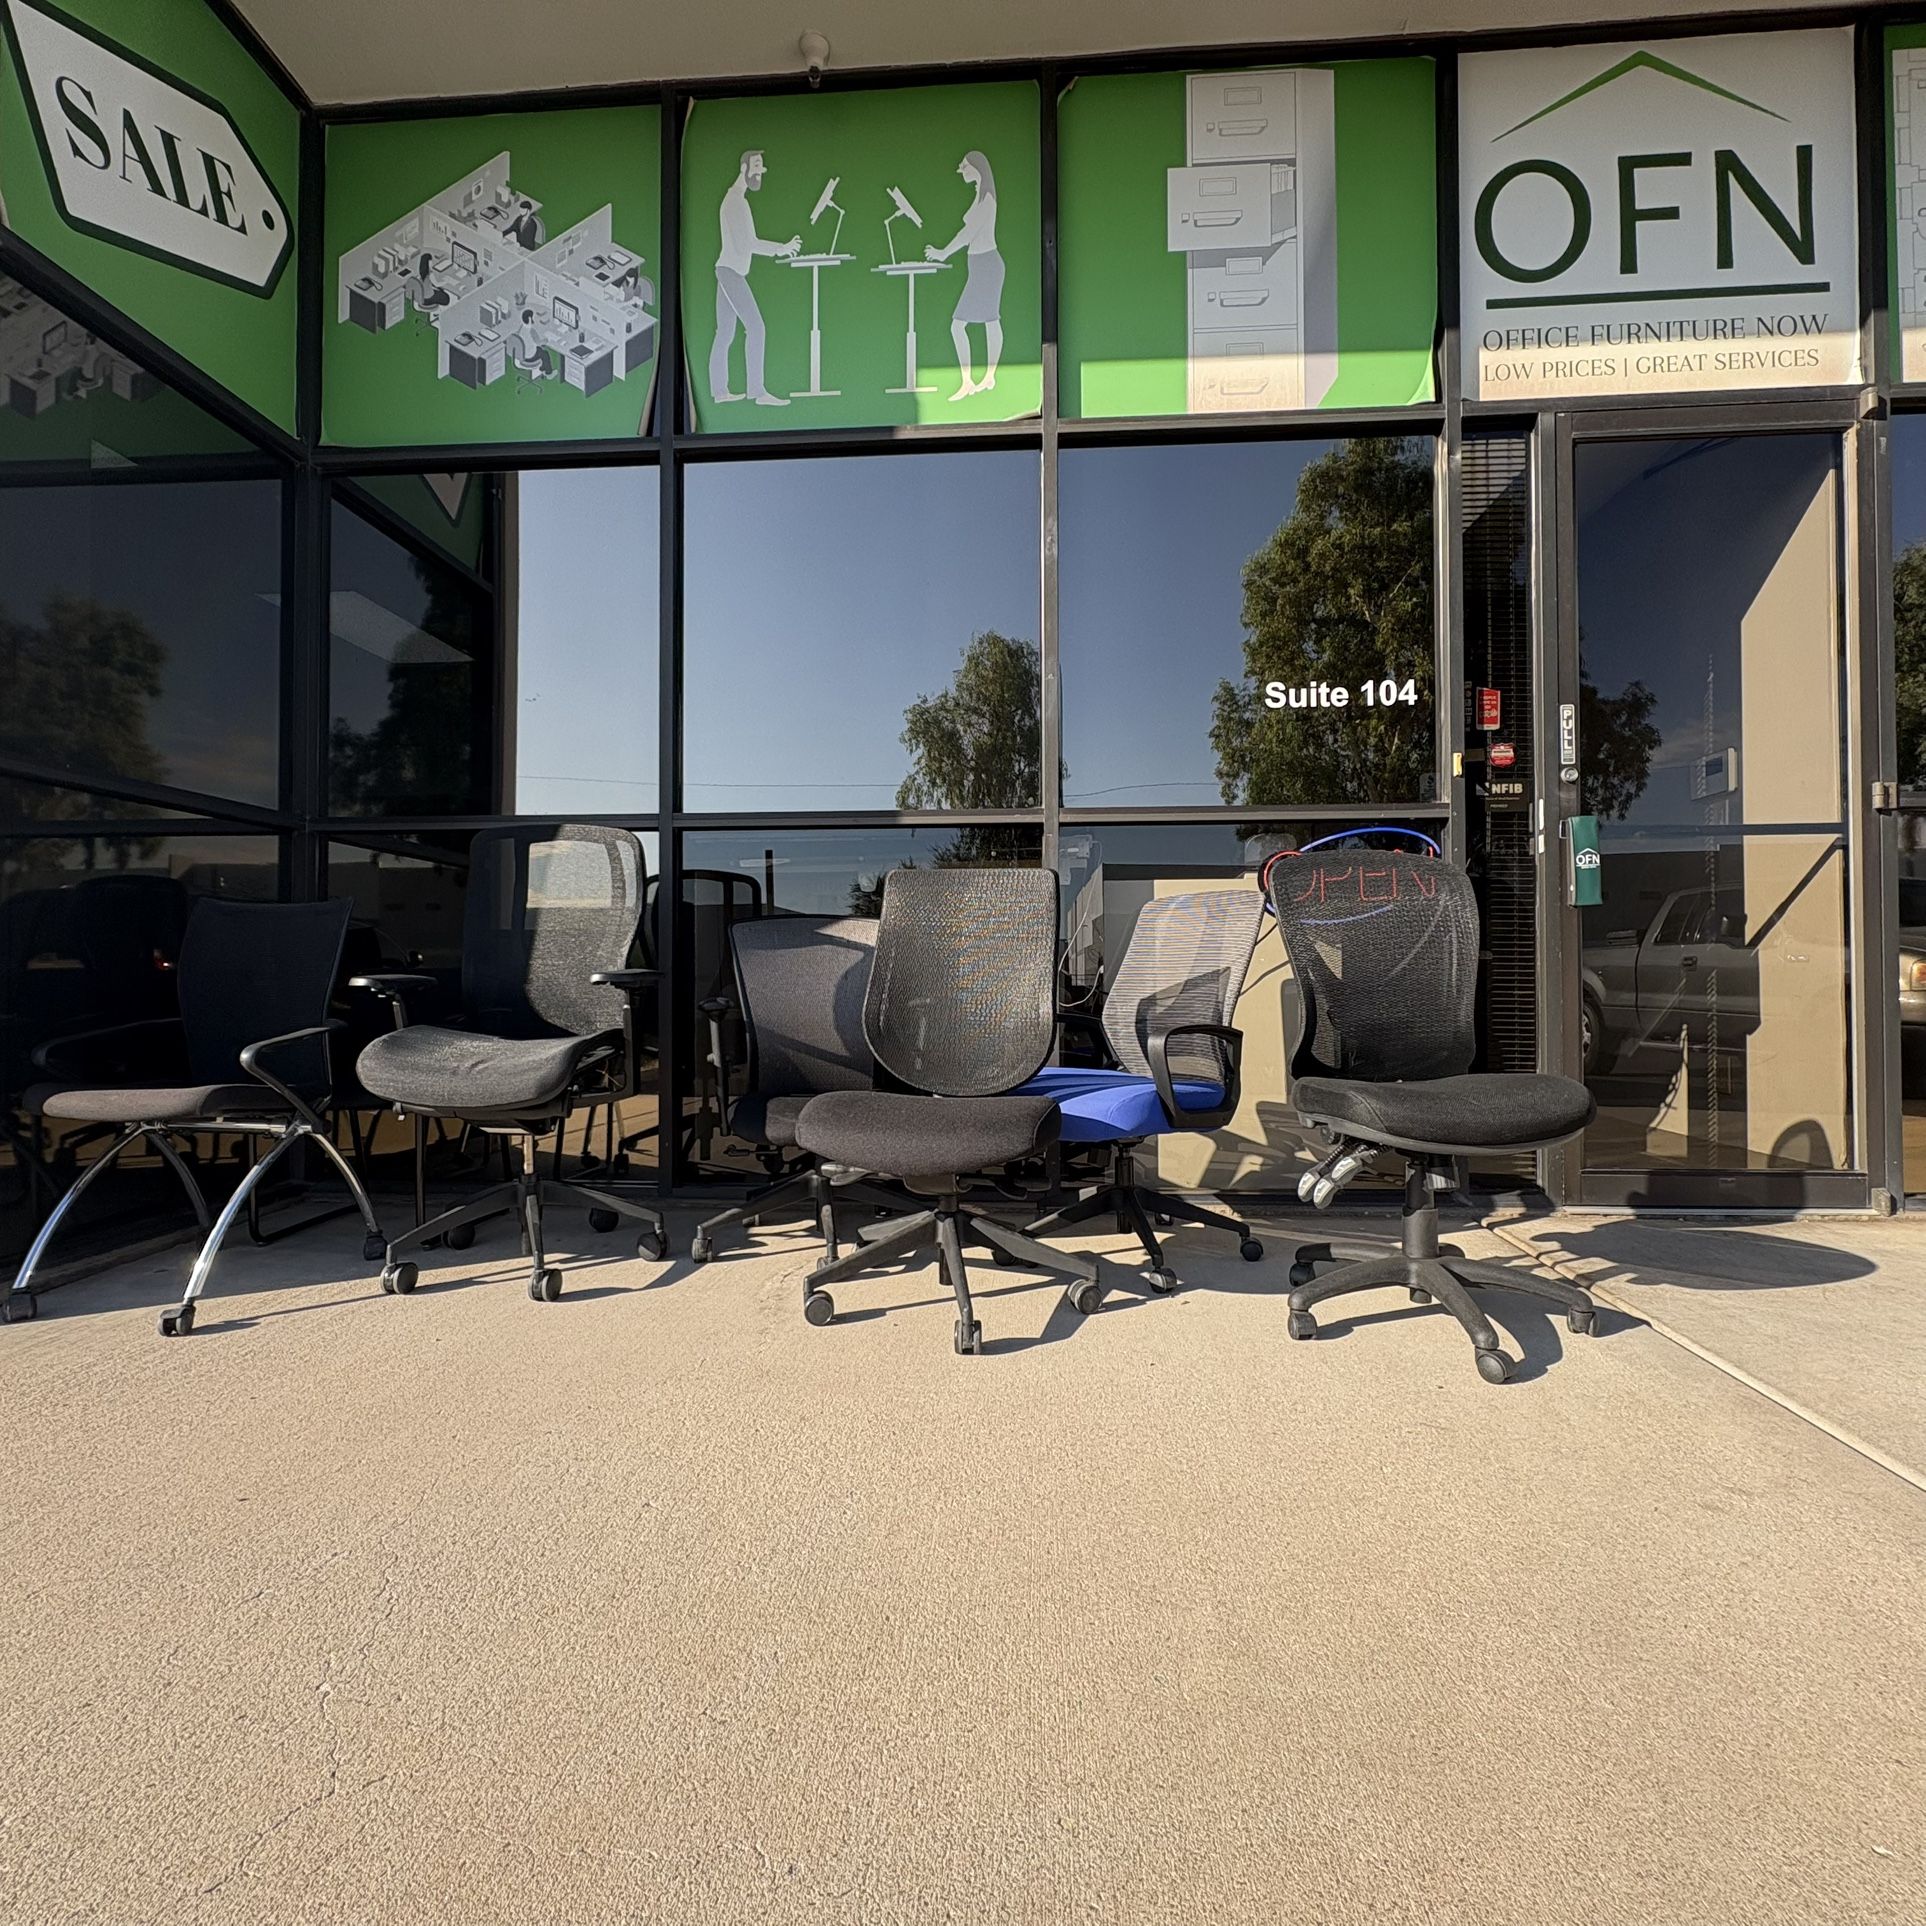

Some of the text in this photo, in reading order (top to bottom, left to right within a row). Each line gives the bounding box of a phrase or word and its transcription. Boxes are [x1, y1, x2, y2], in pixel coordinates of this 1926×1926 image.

[54, 75, 248, 236] SALE
[1474, 144, 1815, 284] OFN
[1482, 313, 1829, 352] OFFICE FURNITURE NOW
[1483, 361, 1534, 382] LOW
[1542, 356, 1616, 379] PRICES
[1636, 353, 1708, 375] GREAT
[1714, 348, 1820, 372] SERVICES
[1264, 678, 1418, 709] Suite 104
[1562, 709, 1573, 750] PULL
[1491, 783, 1523, 794] NFIB
[1575, 853, 1601, 865] OFN
